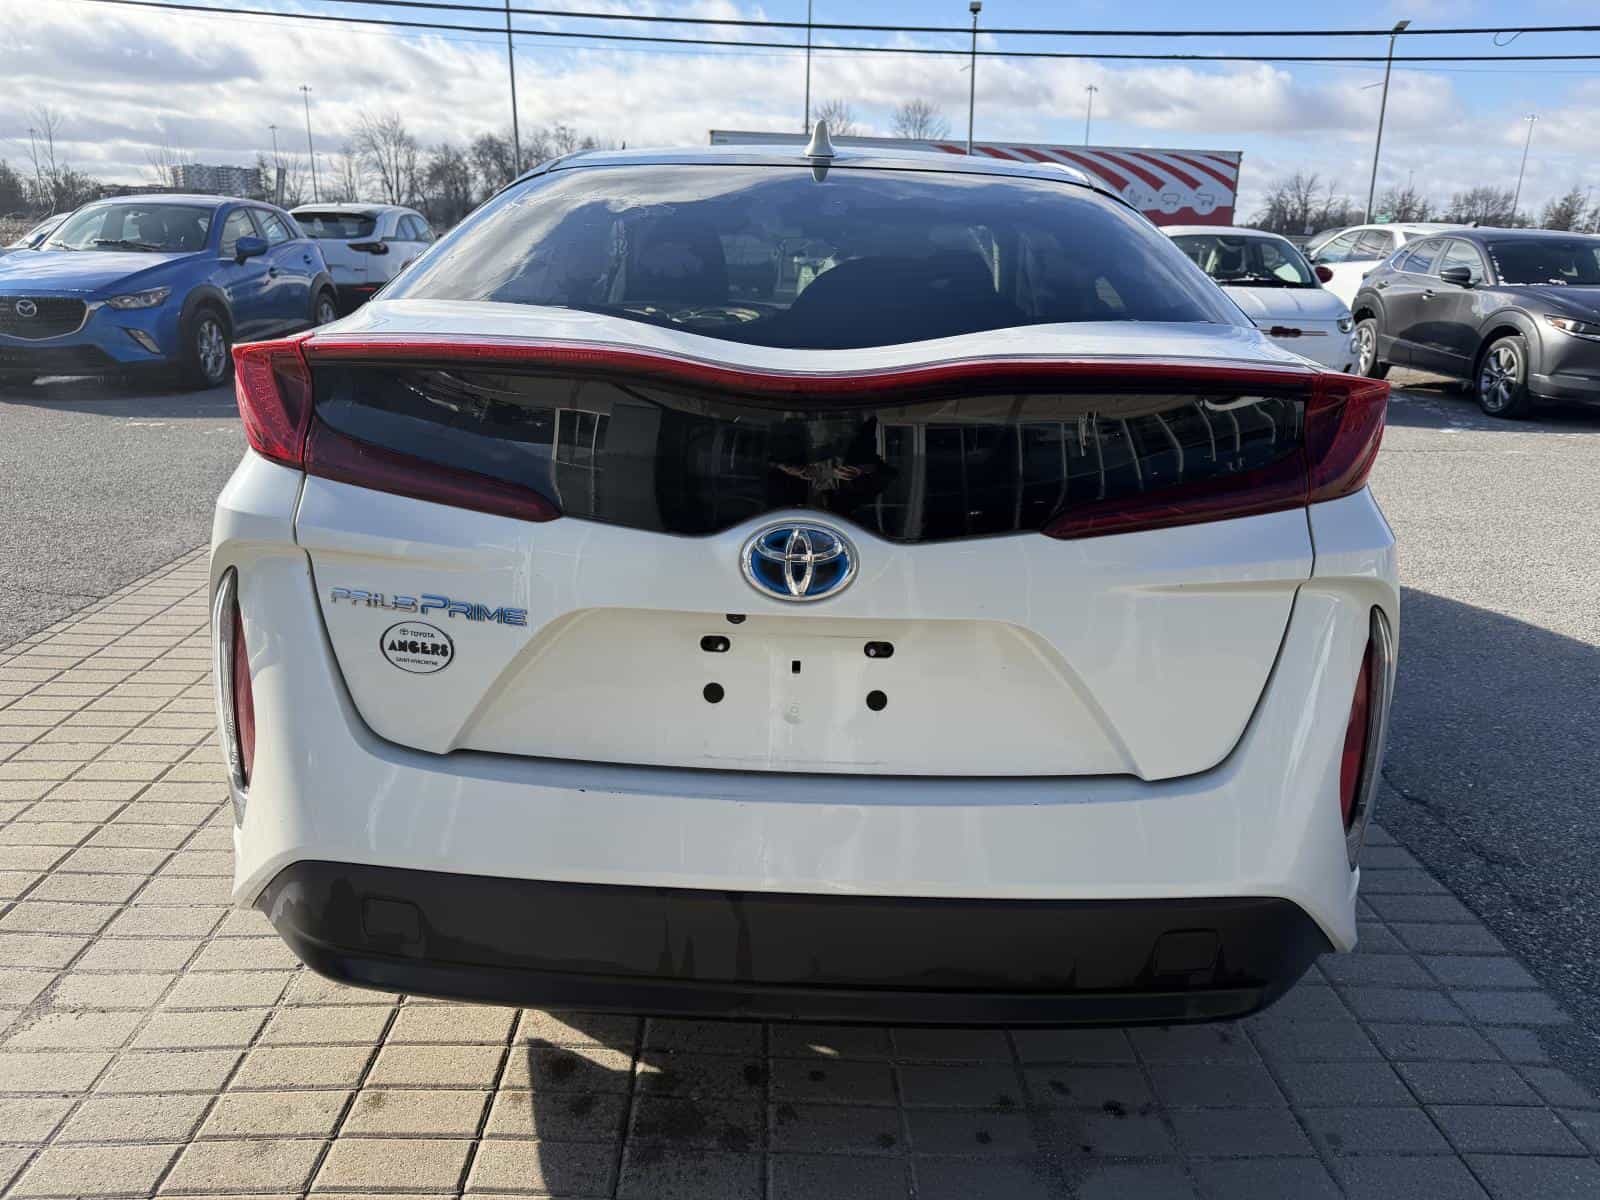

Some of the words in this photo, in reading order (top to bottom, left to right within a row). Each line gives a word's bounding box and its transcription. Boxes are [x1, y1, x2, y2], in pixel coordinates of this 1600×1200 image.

[331, 586, 419, 613] PRIUS
[420, 593, 528, 626] PRIME
[410, 630, 436, 639] TOYOTA
[388, 640, 449, 657] ANGERS
